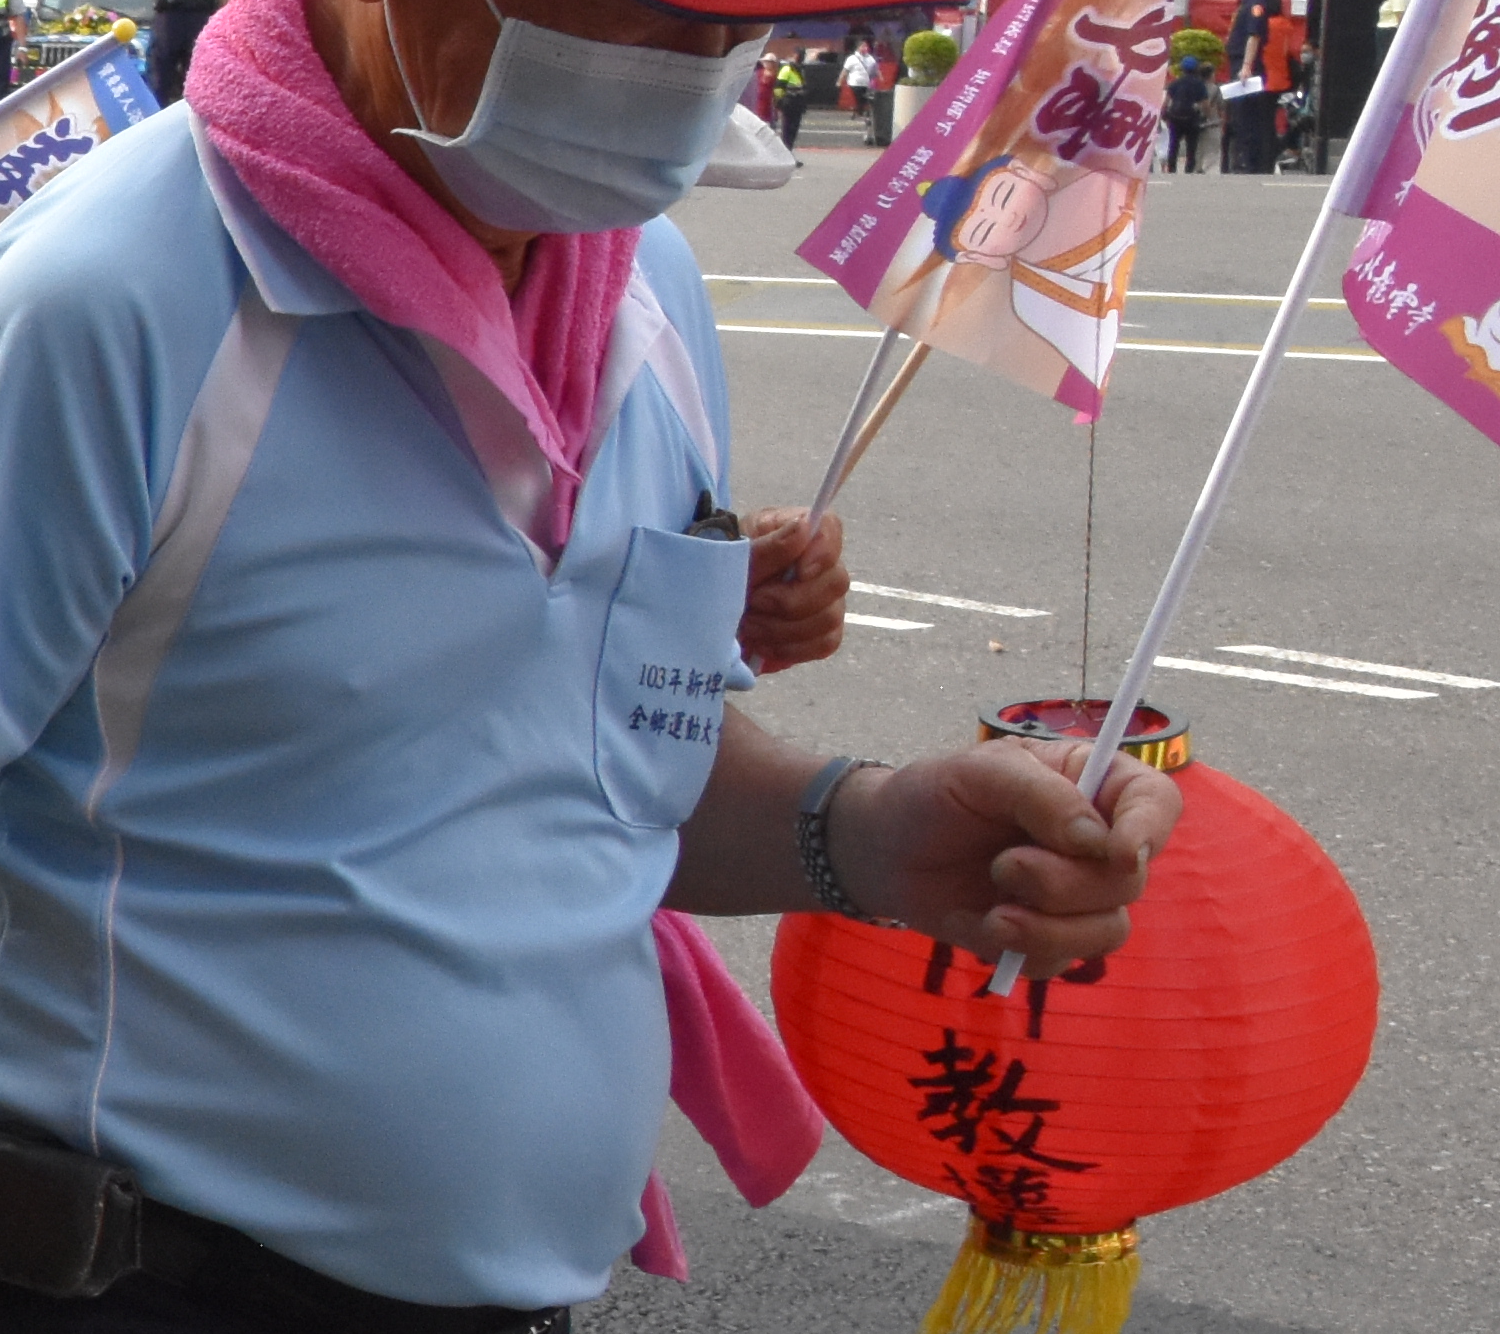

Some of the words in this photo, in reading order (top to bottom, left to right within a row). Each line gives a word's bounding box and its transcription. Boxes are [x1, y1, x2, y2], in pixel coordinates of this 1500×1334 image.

[628, 704, 722, 746] 全鄉運動大
